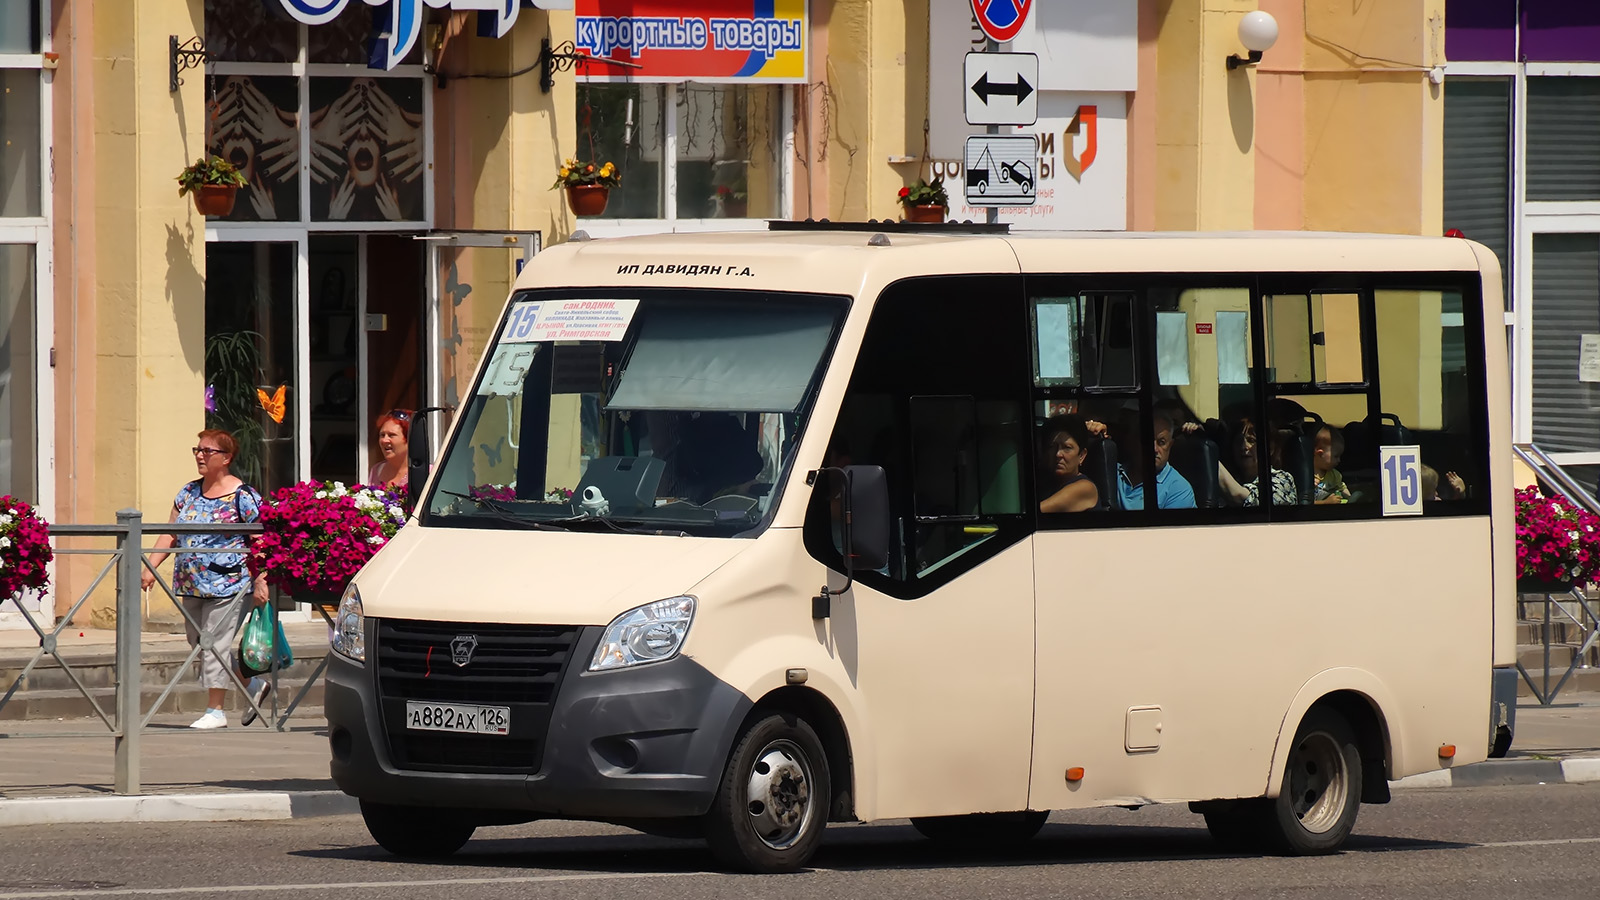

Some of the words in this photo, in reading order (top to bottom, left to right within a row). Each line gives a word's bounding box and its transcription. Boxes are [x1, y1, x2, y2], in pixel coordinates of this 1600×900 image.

[576, 17, 707, 57] курортные
[710, 18, 802, 59] товары
[968, 206, 1027, 216] муниальные
[1030, 204, 1054, 217] услуги
[617, 265, 640, 275] ИП
[642, 264, 722, 276] ДАВИДЯН
[726, 266, 755, 277] Г.А.
[507, 305, 540, 339] 15
[559, 329, 611, 338] Римгорская
[1384, 454, 1418, 505] 15
[412, 706, 476, 730] А882АХ
[480, 709, 504, 725] 126
